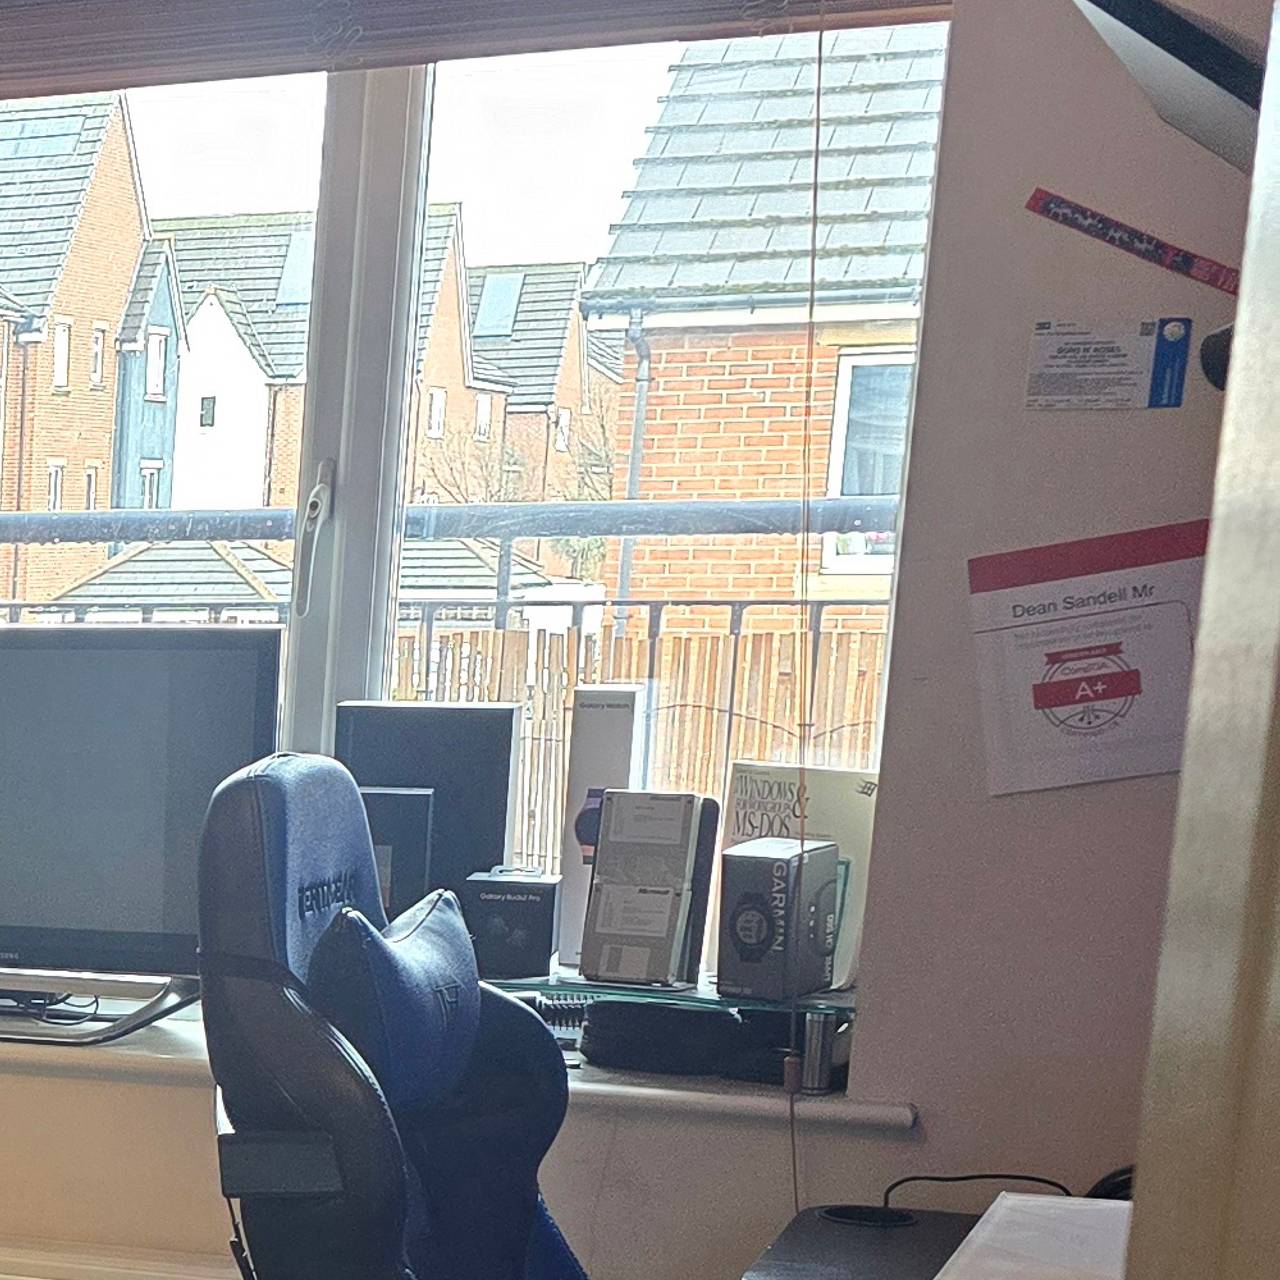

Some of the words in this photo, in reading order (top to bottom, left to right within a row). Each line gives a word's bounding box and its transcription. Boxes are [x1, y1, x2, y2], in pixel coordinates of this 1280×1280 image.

[1011, 601, 1057, 619] Dean
[1062, 587, 1128, 611] Sandell
[1132, 584, 1155, 599] Mr
[1075, 680, 1108, 700] A+
[734, 774, 796, 803] WINDOWS
[771, 861, 788, 952] GARMIN
